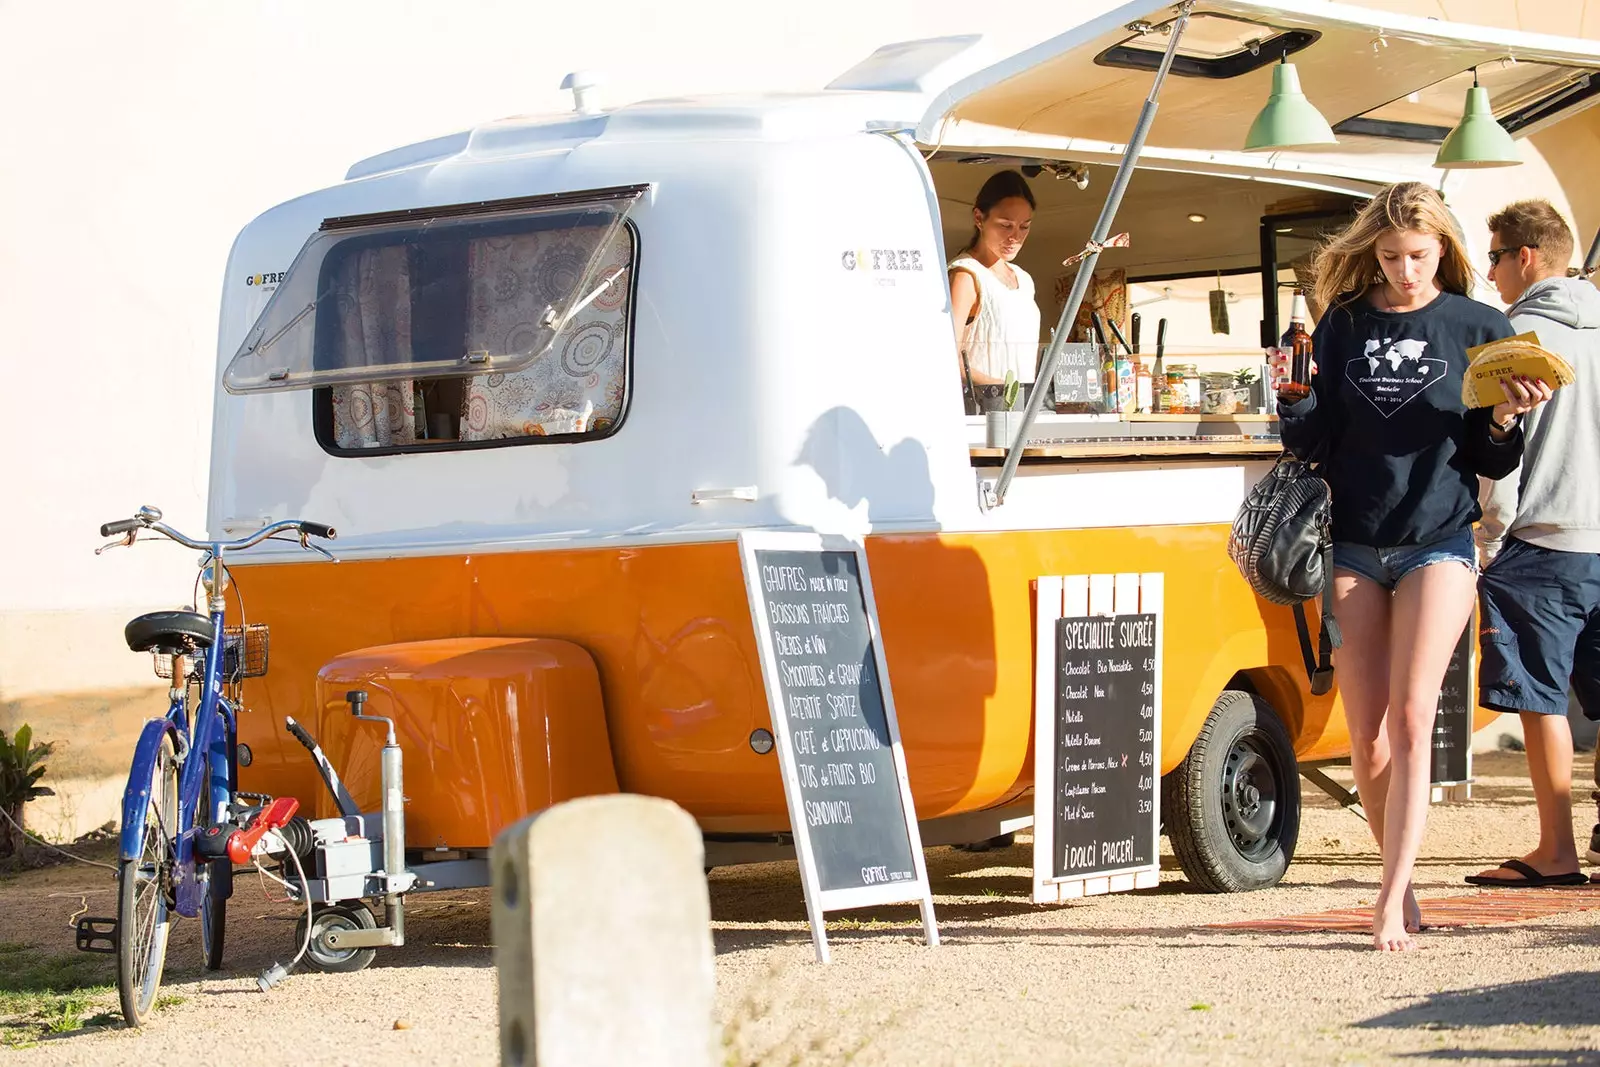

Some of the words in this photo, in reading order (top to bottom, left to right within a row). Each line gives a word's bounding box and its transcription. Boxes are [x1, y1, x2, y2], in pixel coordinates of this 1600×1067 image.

[246, 271, 288, 286] GOFRE
[1404, 376, 1425, 384] School
[1475, 366, 1515, 380] GOFREE
[1376, 385, 1401, 393] Bachelor
[762, 565, 807, 593] GAUFRES
[808, 577, 827, 593] MADE
[769, 601, 810, 625] BOISSONS
[1119, 615, 1154, 648] SUCRÉE
[811, 632, 828, 655] VIN
[780, 659, 827, 688] SMOOTHIES
[836, 661, 872, 686] GRANITA
[1065, 660, 1091, 676] Chocolat
[1097, 659, 1108, 674] Bio
[1142, 657, 1156, 672] 4,50
[1065, 684, 1089, 700] Chocolat
[1140, 681, 1154, 696] 4,50
[789, 693, 822, 720] APERITIF
[826, 692, 858, 720] SPRITZ
[1065, 709, 1084, 724] Nutella
[1139, 703, 1153, 720] 4,00
[794, 726, 818, 755] CAFÉ
[830, 726, 881, 753] CAPPUCCINO
[1064, 733, 1083, 747] Nutella
[1139, 728, 1153, 743] 5,00
[1081, 759, 1088, 771] de
[1138, 750, 1153, 768] 4,50
[799, 763, 819, 789] JUS
[820, 767, 830, 787] de
[827, 763, 857, 786] FRUITS
[858, 762, 877, 785] BIO
[1138, 774, 1153, 791] 4,00
[804, 799, 854, 827] SANDWICH
[1064, 805, 1076, 821] Miel
[1138, 799, 1153, 814] 3,50
[861, 865, 890, 885] GOFREE
